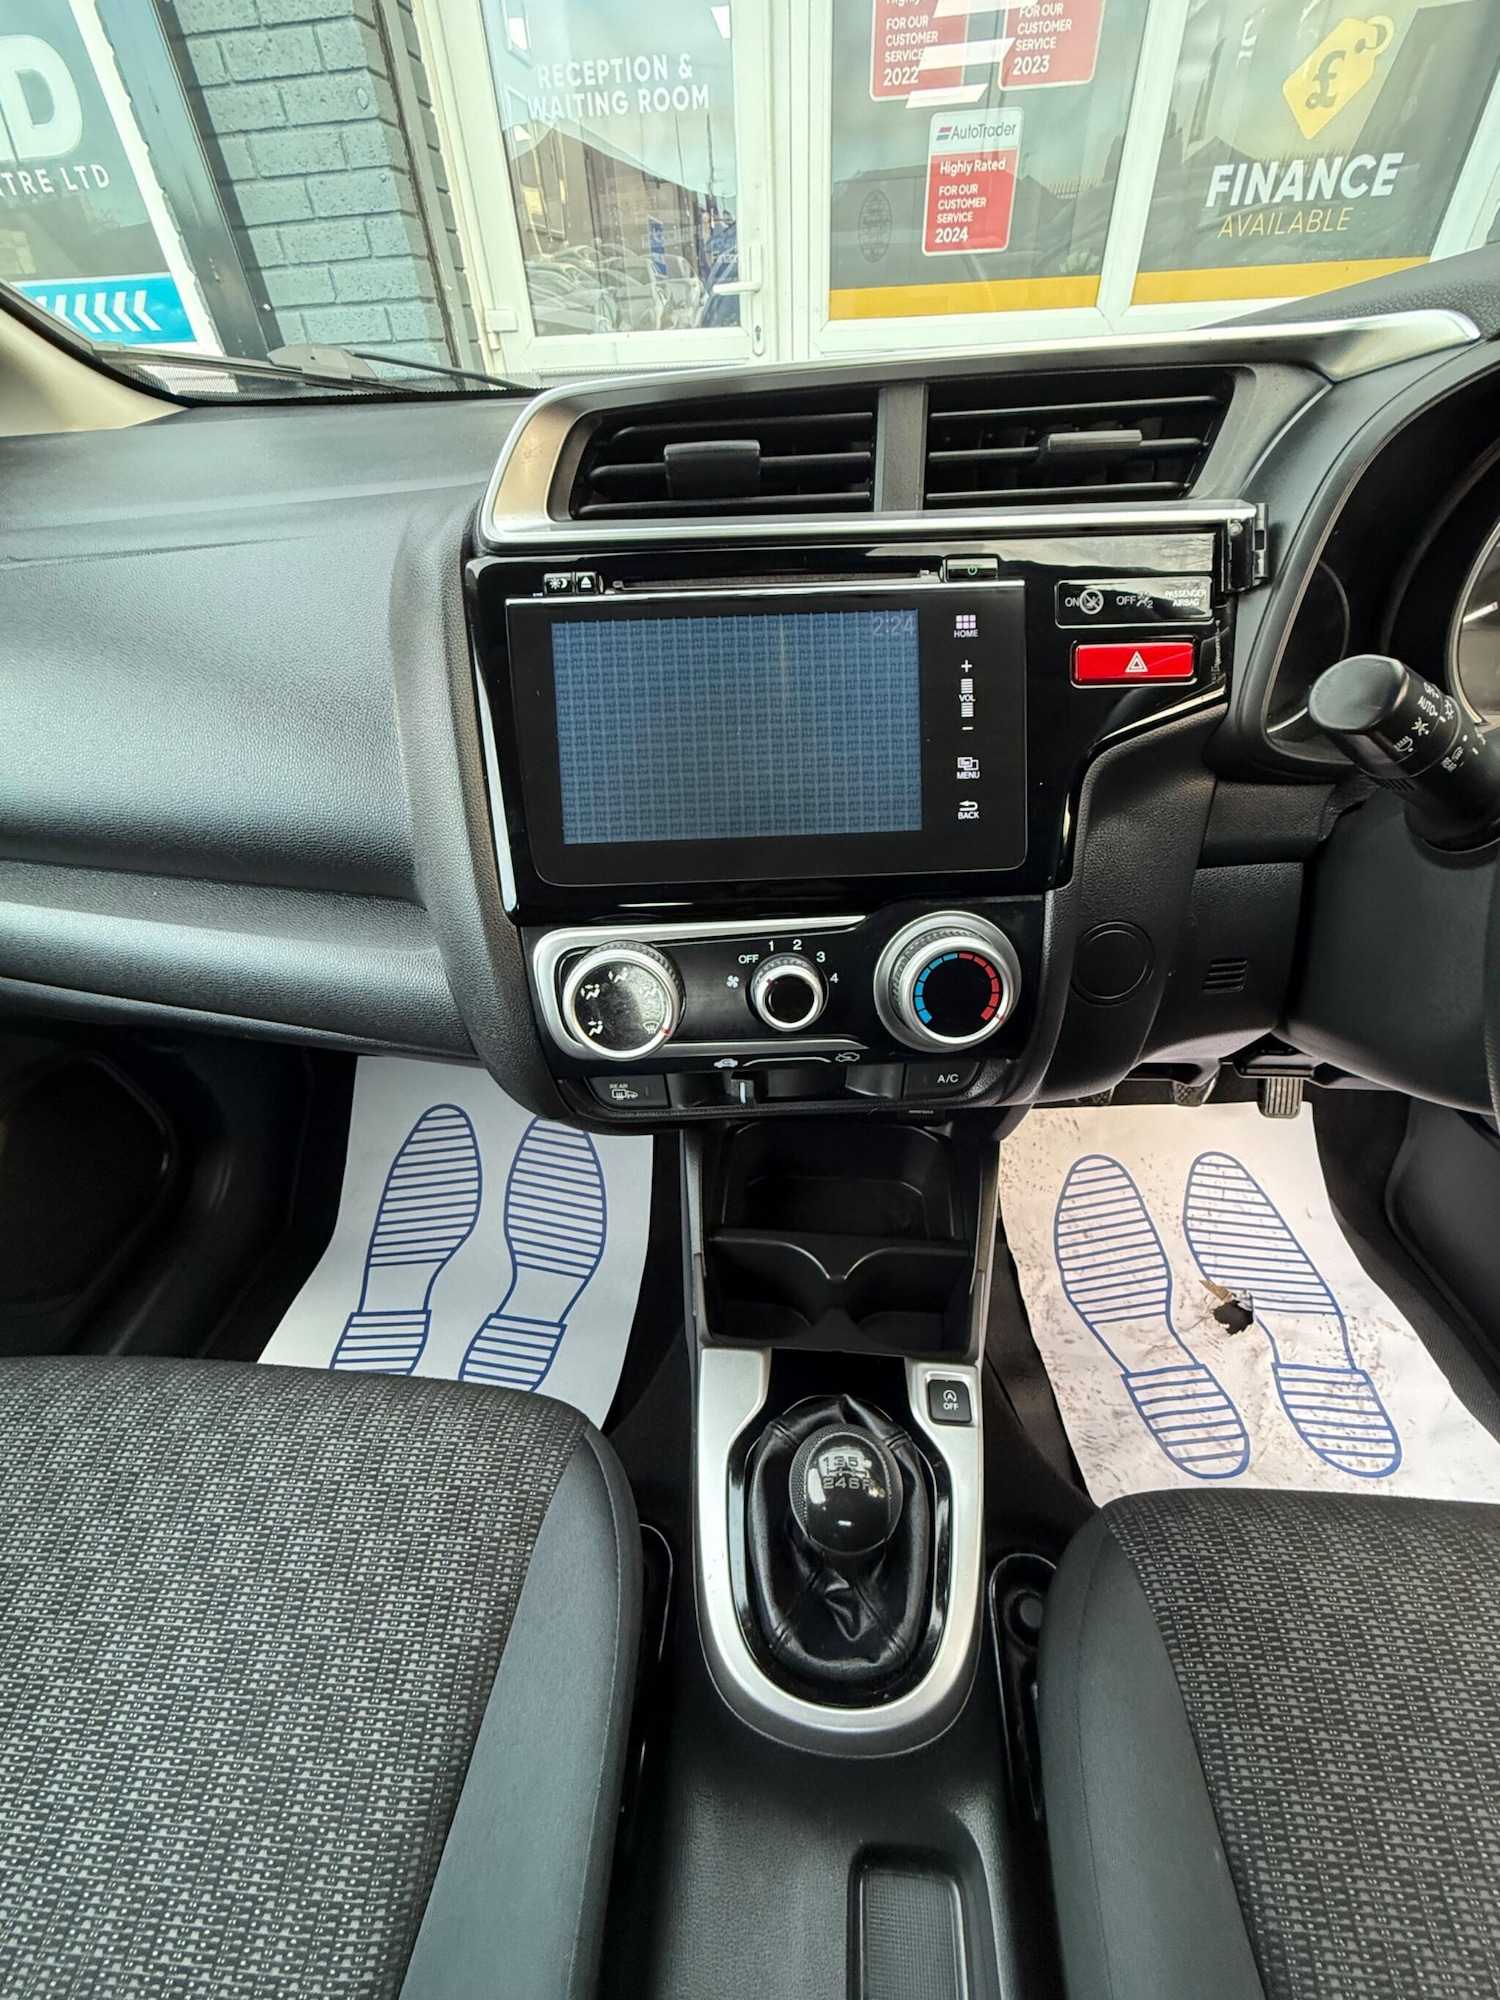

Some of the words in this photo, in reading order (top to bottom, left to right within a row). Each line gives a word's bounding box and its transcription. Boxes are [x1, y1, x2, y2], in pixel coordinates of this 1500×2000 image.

[1020, 5, 1040, 18] FOR
[1041, 3, 1064, 17] OUR
[885, 17, 907, 31] FOR
[907, 15, 929, 29] OUR
[1017, 18, 1072, 35] CUSTOMER
[885, 30, 938, 47] CUSTOMER
[1015, 36, 1057, 51] SERVICE
[884, 48, 924, 63] SERVICE
[537, 54, 668, 89] RECEPTION
[678, 52, 693, 79] &
[1012, 54, 1050, 75] 2023
[883, 67, 919, 86] 2022
[0, 34, 83, 162] D
[527, 89, 629, 121] WAITING
[637, 84, 710, 113] ROOM
[951, 122, 1017, 140] AutoTrader
[940, 160, 973, 177] Highly
[974, 157, 1006, 172] Rated
[0, 169, 54, 197] TRE
[60, 164, 110, 190] LTD
[1205, 152, 1405, 208] FINANCE
[938, 185, 957, 196] FOR
[958, 183, 979, 195] OUR
[937, 197, 987, 210] CUSTOMER
[936, 212, 974, 224] SERVICE
[1217, 207, 1354, 239] AVAILABLE
[934, 226, 969, 244] 2024
[1064, 597, 1080, 607] ON
[1116, 595, 1137, 606] OFF
[1164, 589, 1207, 602] PASSENGER
[1172, 599, 1200, 607] AIRBAG
[872, 615, 916, 636] 2:24
[954, 629, 979, 638] HOME
[959, 694, 976, 702] VOL
[1417, 695, 1437, 717] AUTO
[956, 771, 980, 780] MENU
[958, 811, 980, 820] BACK
[768, 940, 774, 951] 1
[792, 939, 803, 950] 2
[738, 954, 760, 964] OFF
[815, 951, 826, 963] 3
[829, 972, 840, 984] 4
[936, 1073, 959, 1083] A/C
[943, 1402, 959, 1410] OFF
